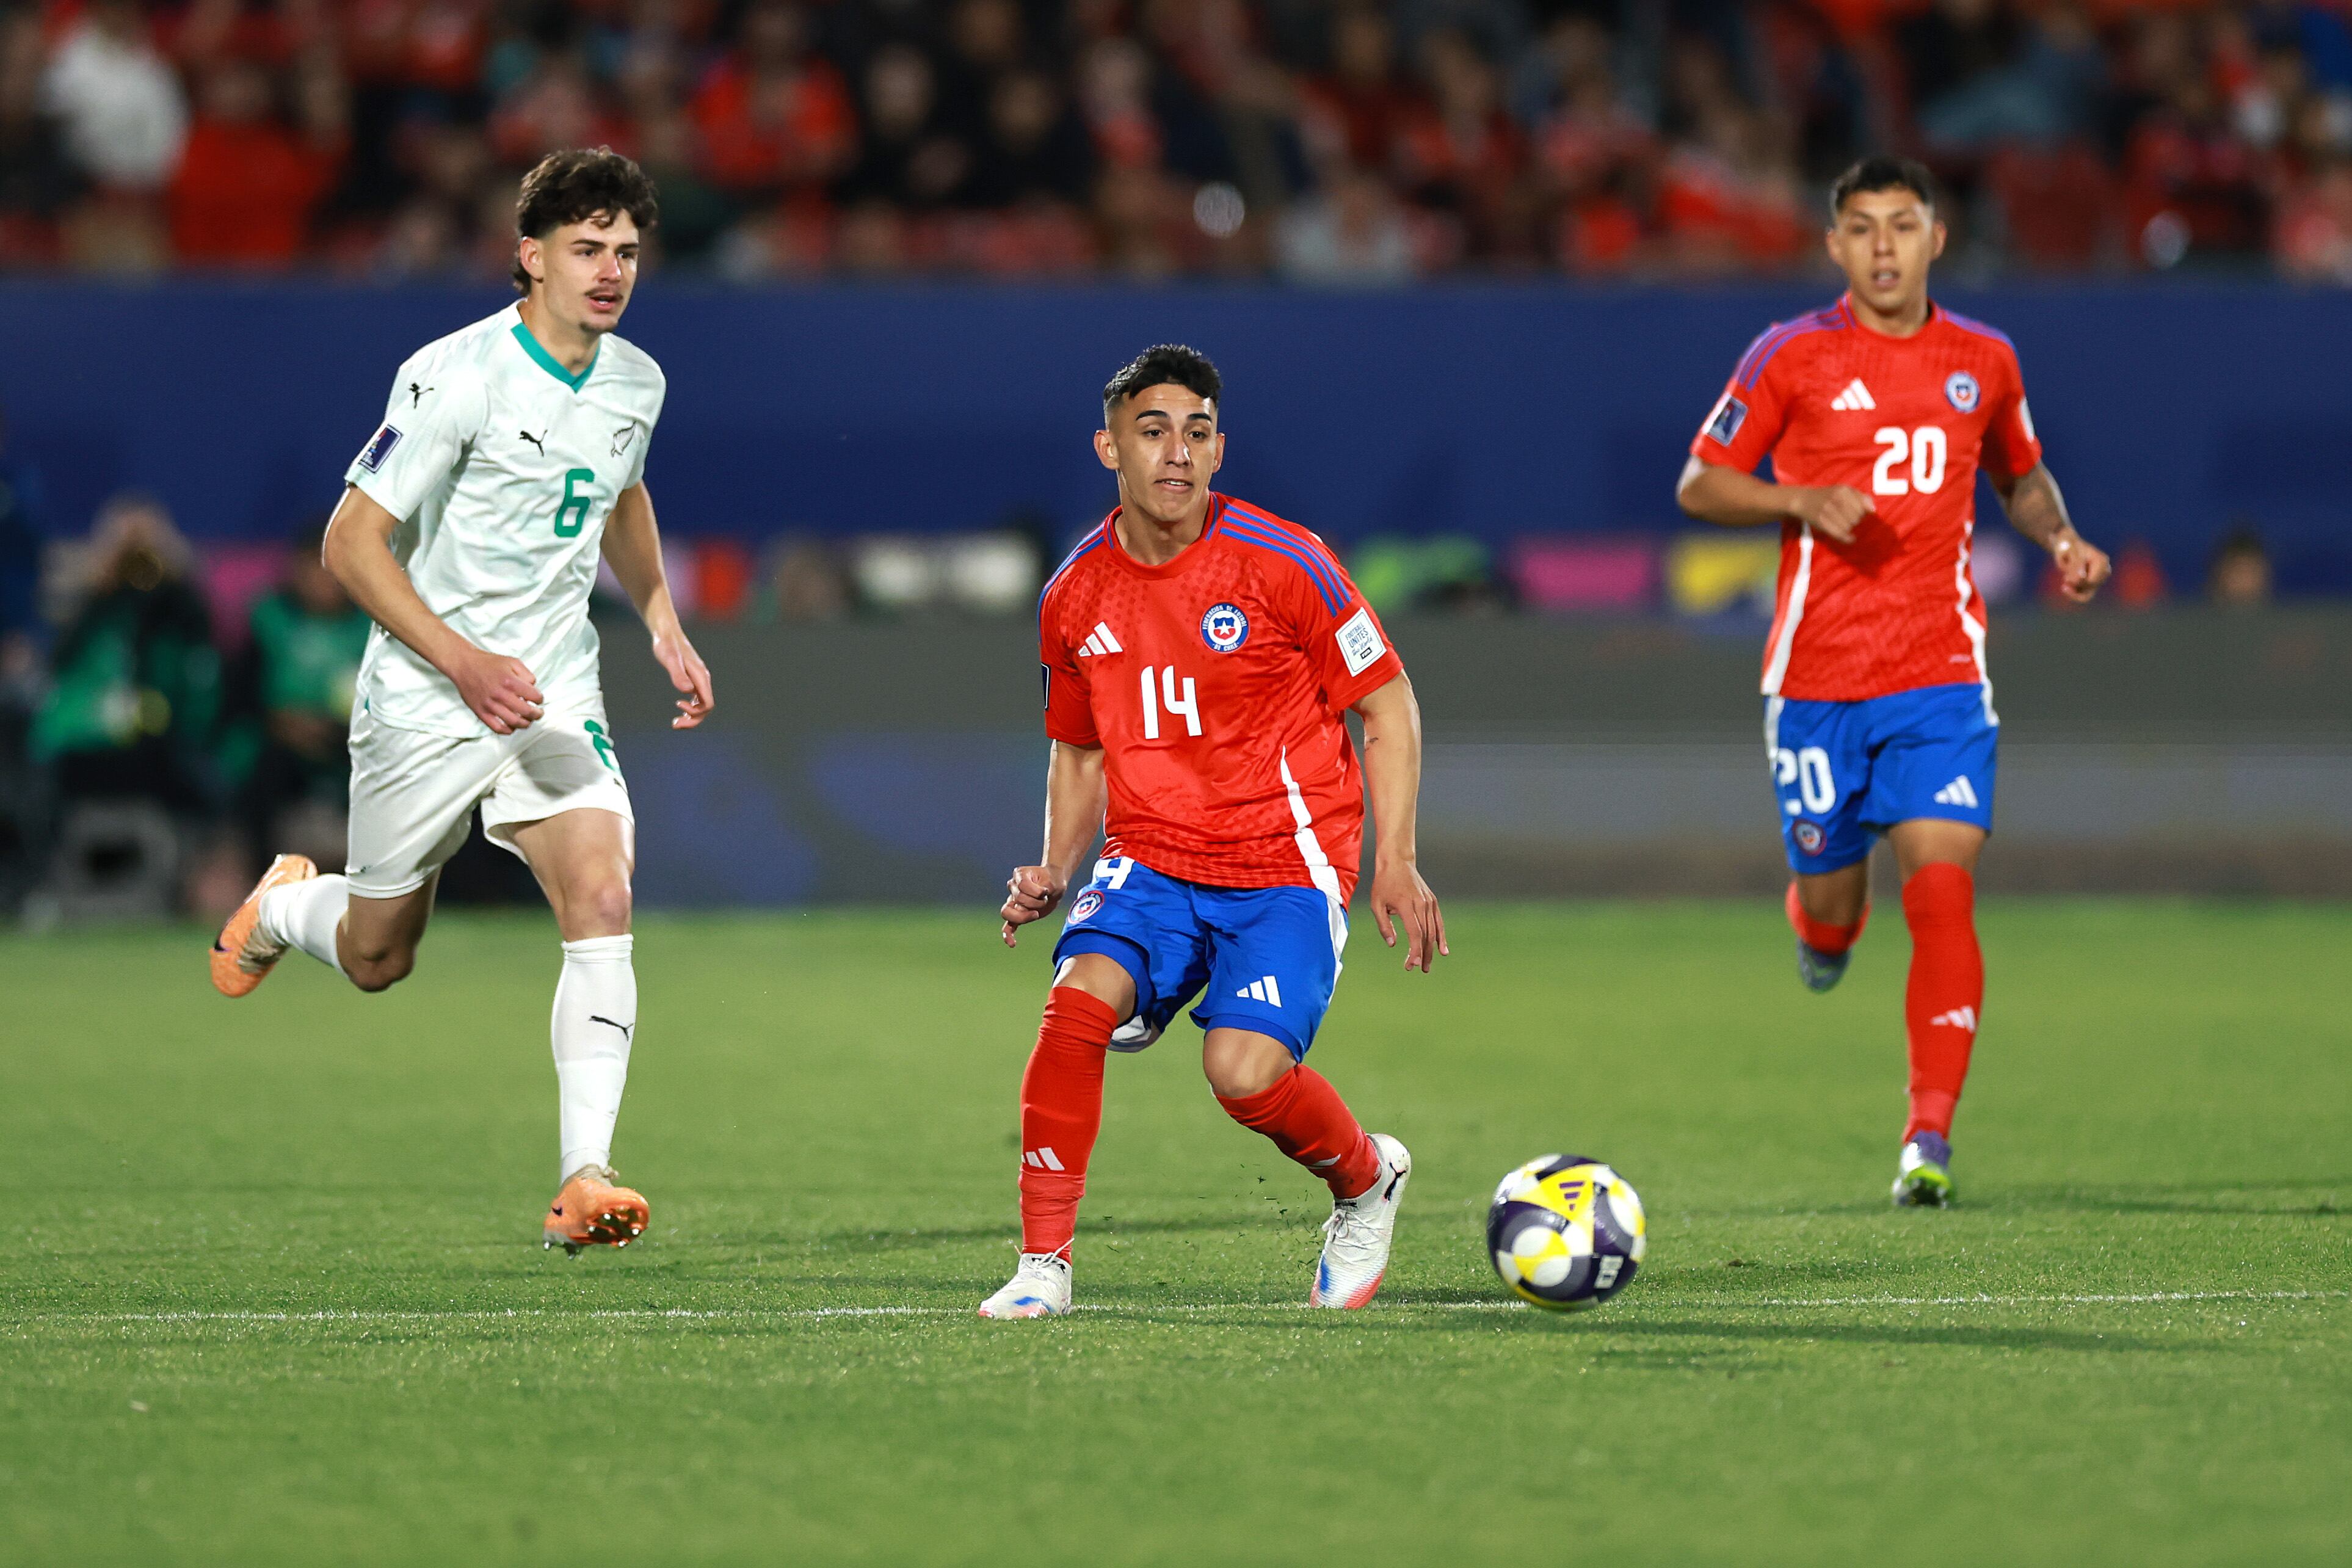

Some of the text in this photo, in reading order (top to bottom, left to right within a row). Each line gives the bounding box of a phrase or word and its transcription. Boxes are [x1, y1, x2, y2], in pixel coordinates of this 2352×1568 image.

[1873, 426, 1947, 495] 20
[554, 468, 595, 538] 6
[1224, 642, 1239, 652] CHILE
[1346, 622, 1364, 640] FOOTBALL
[1348, 628, 1368, 647] UNITES
[1141, 666, 1202, 739] 14
